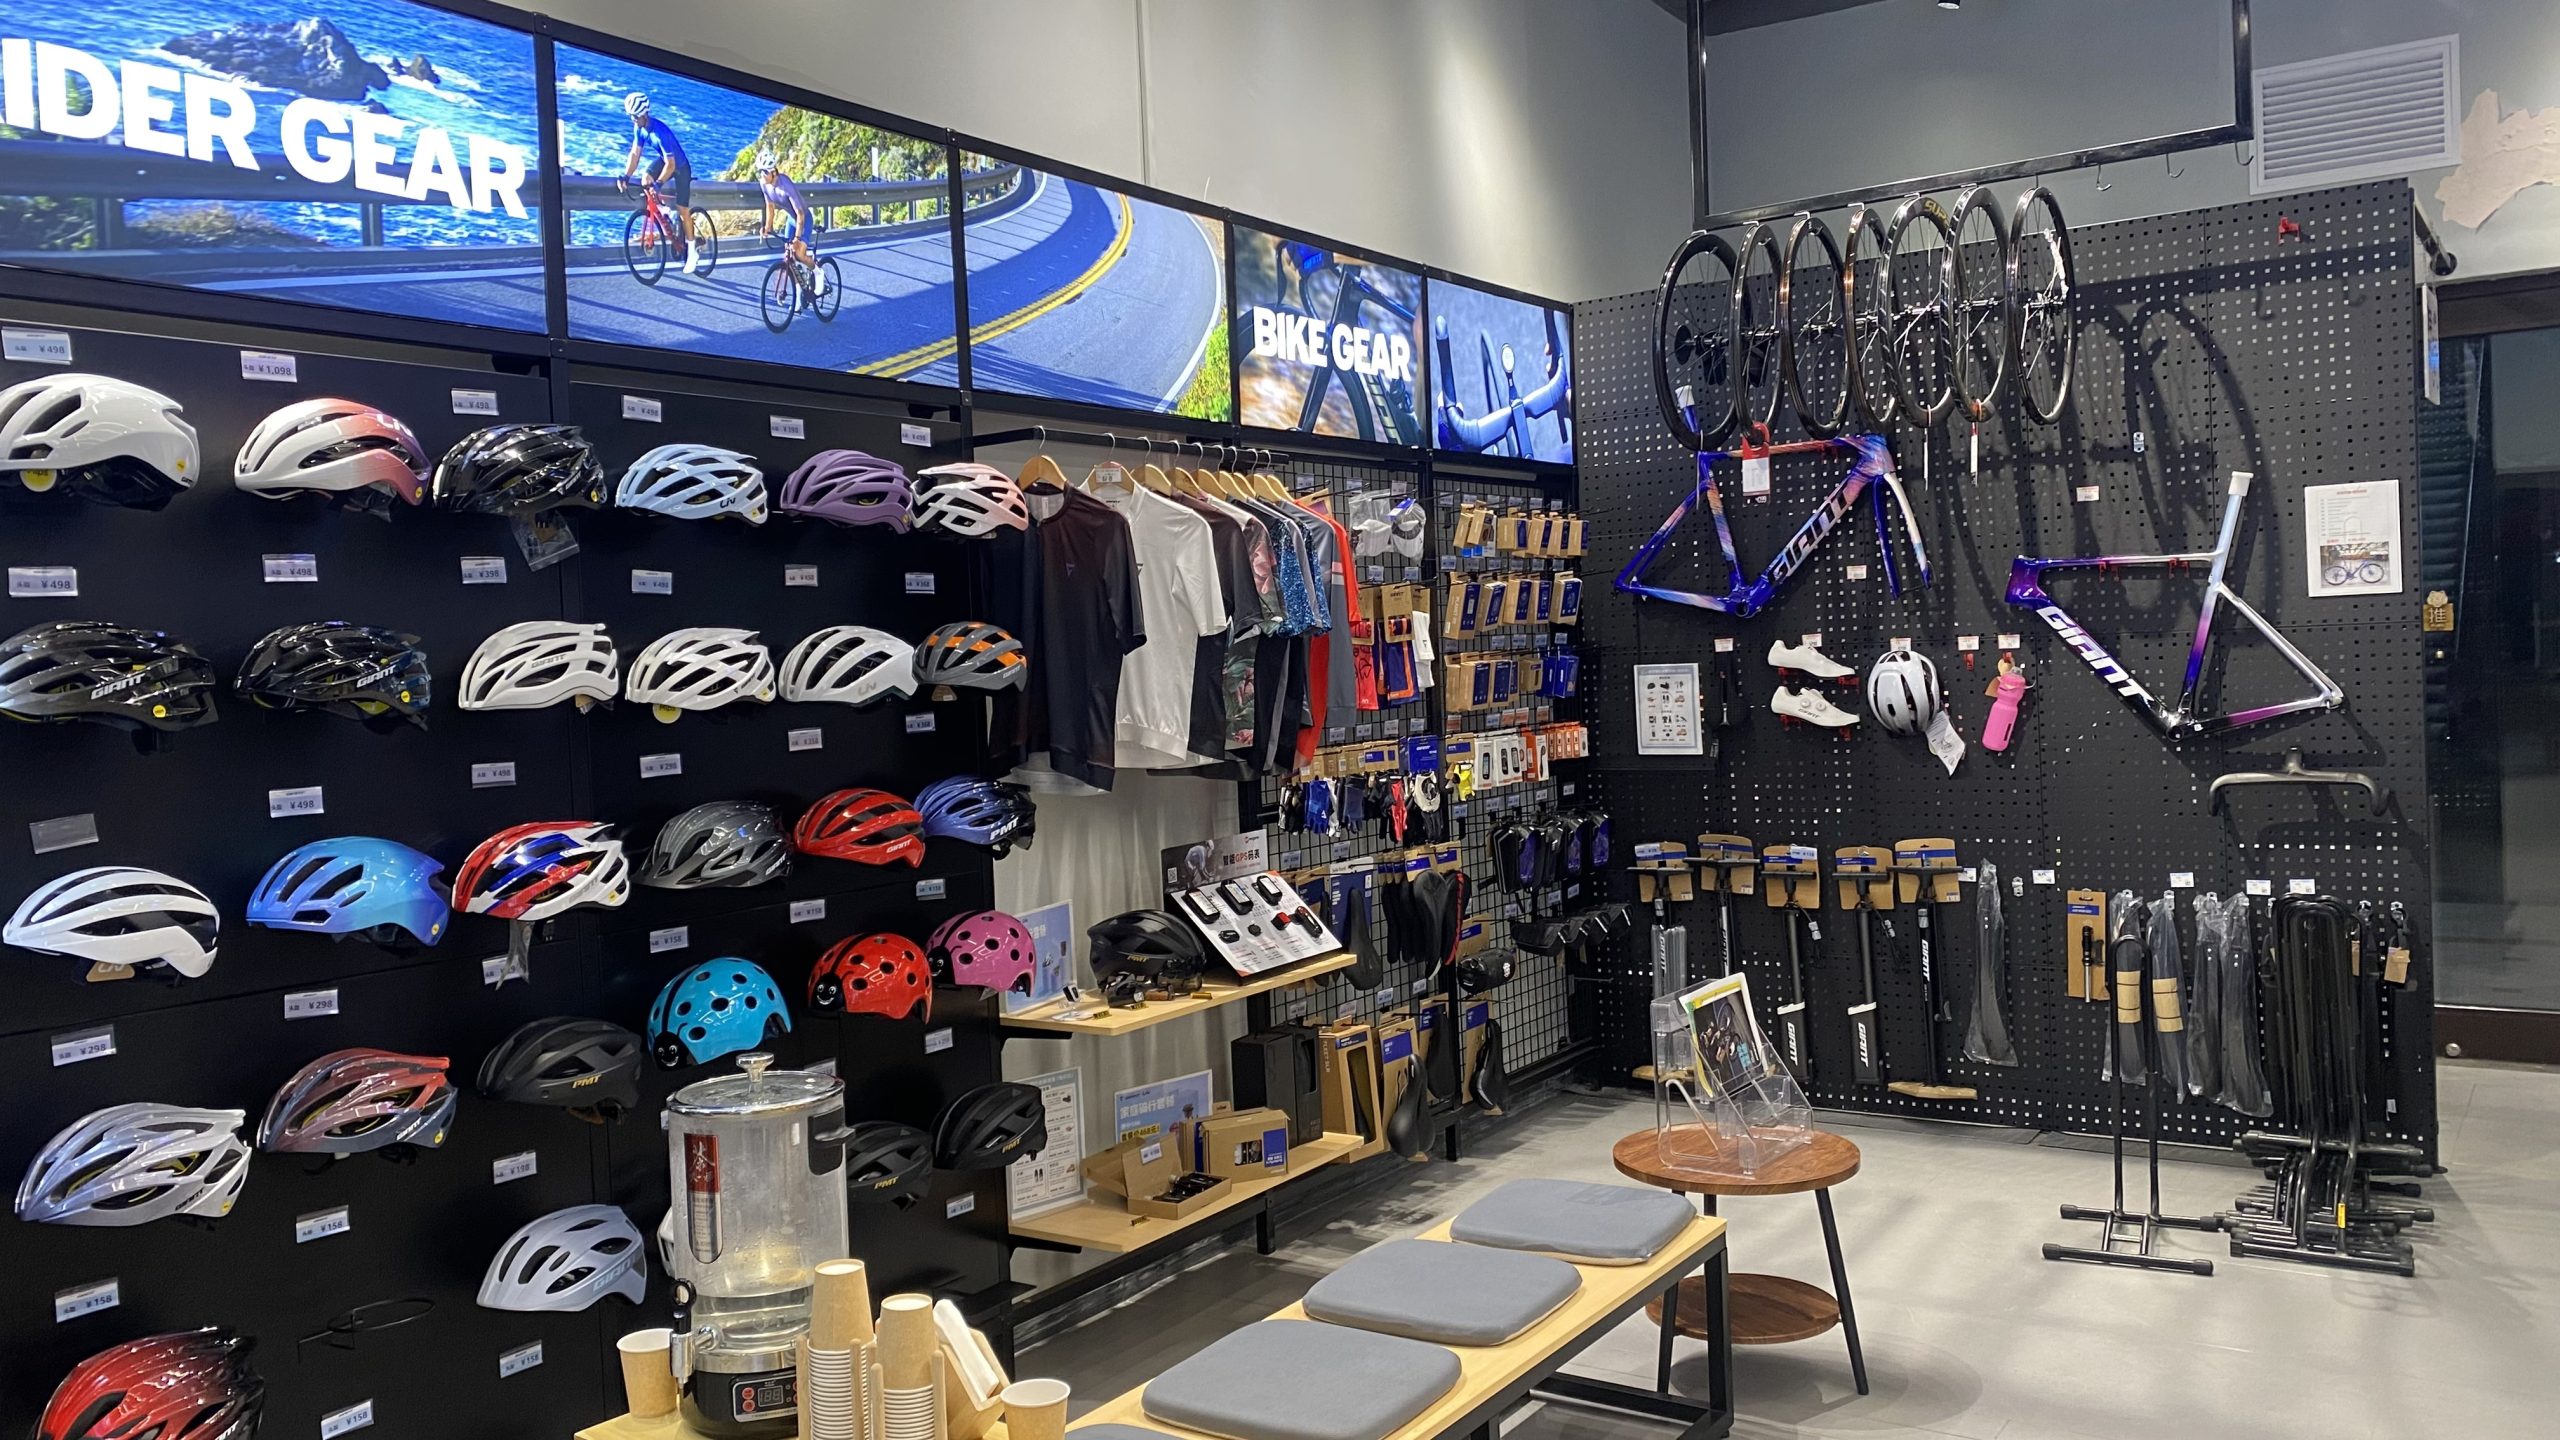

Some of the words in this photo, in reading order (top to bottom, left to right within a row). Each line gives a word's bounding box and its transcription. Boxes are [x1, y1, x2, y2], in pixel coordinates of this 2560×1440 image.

[0, 38, 260, 171] IDER
[280, 97, 529, 220] GEAR
[1253, 306, 1328, 368] BIKE
[1331, 323, 1411, 382] GEAR
[258, 365, 292, 376] ¥1,098
[289, 568, 312, 576] ¥498
[41, 580, 71, 589] ¥498
[2429, 608, 2447, 623] 推
[2037, 606, 2154, 703] GIANT
[356, 665, 396, 688] GIANT
[91, 673, 146, 700] GIANT
[290, 800, 314, 810] ¥498
[990, 816, 1019, 840] PMT
[886, 839, 912, 853] GIANT
[1921, 939, 1930, 982] GIANT
[309, 1000, 333, 1009] ¥298
[80, 1043, 106, 1056] ¥298
[1787, 1022, 1798, 1066] GIANT
[1858, 1022, 1869, 1068] GIANT
[572, 1073, 602, 1089] PMT
[1002, 1138, 1021, 1154] PMT
[874, 1176, 899, 1190] PMT
[321, 1222, 343, 1232] ¥158
[86, 1295, 112, 1308] ¥158
[346, 1411, 368, 1425] ¥158
